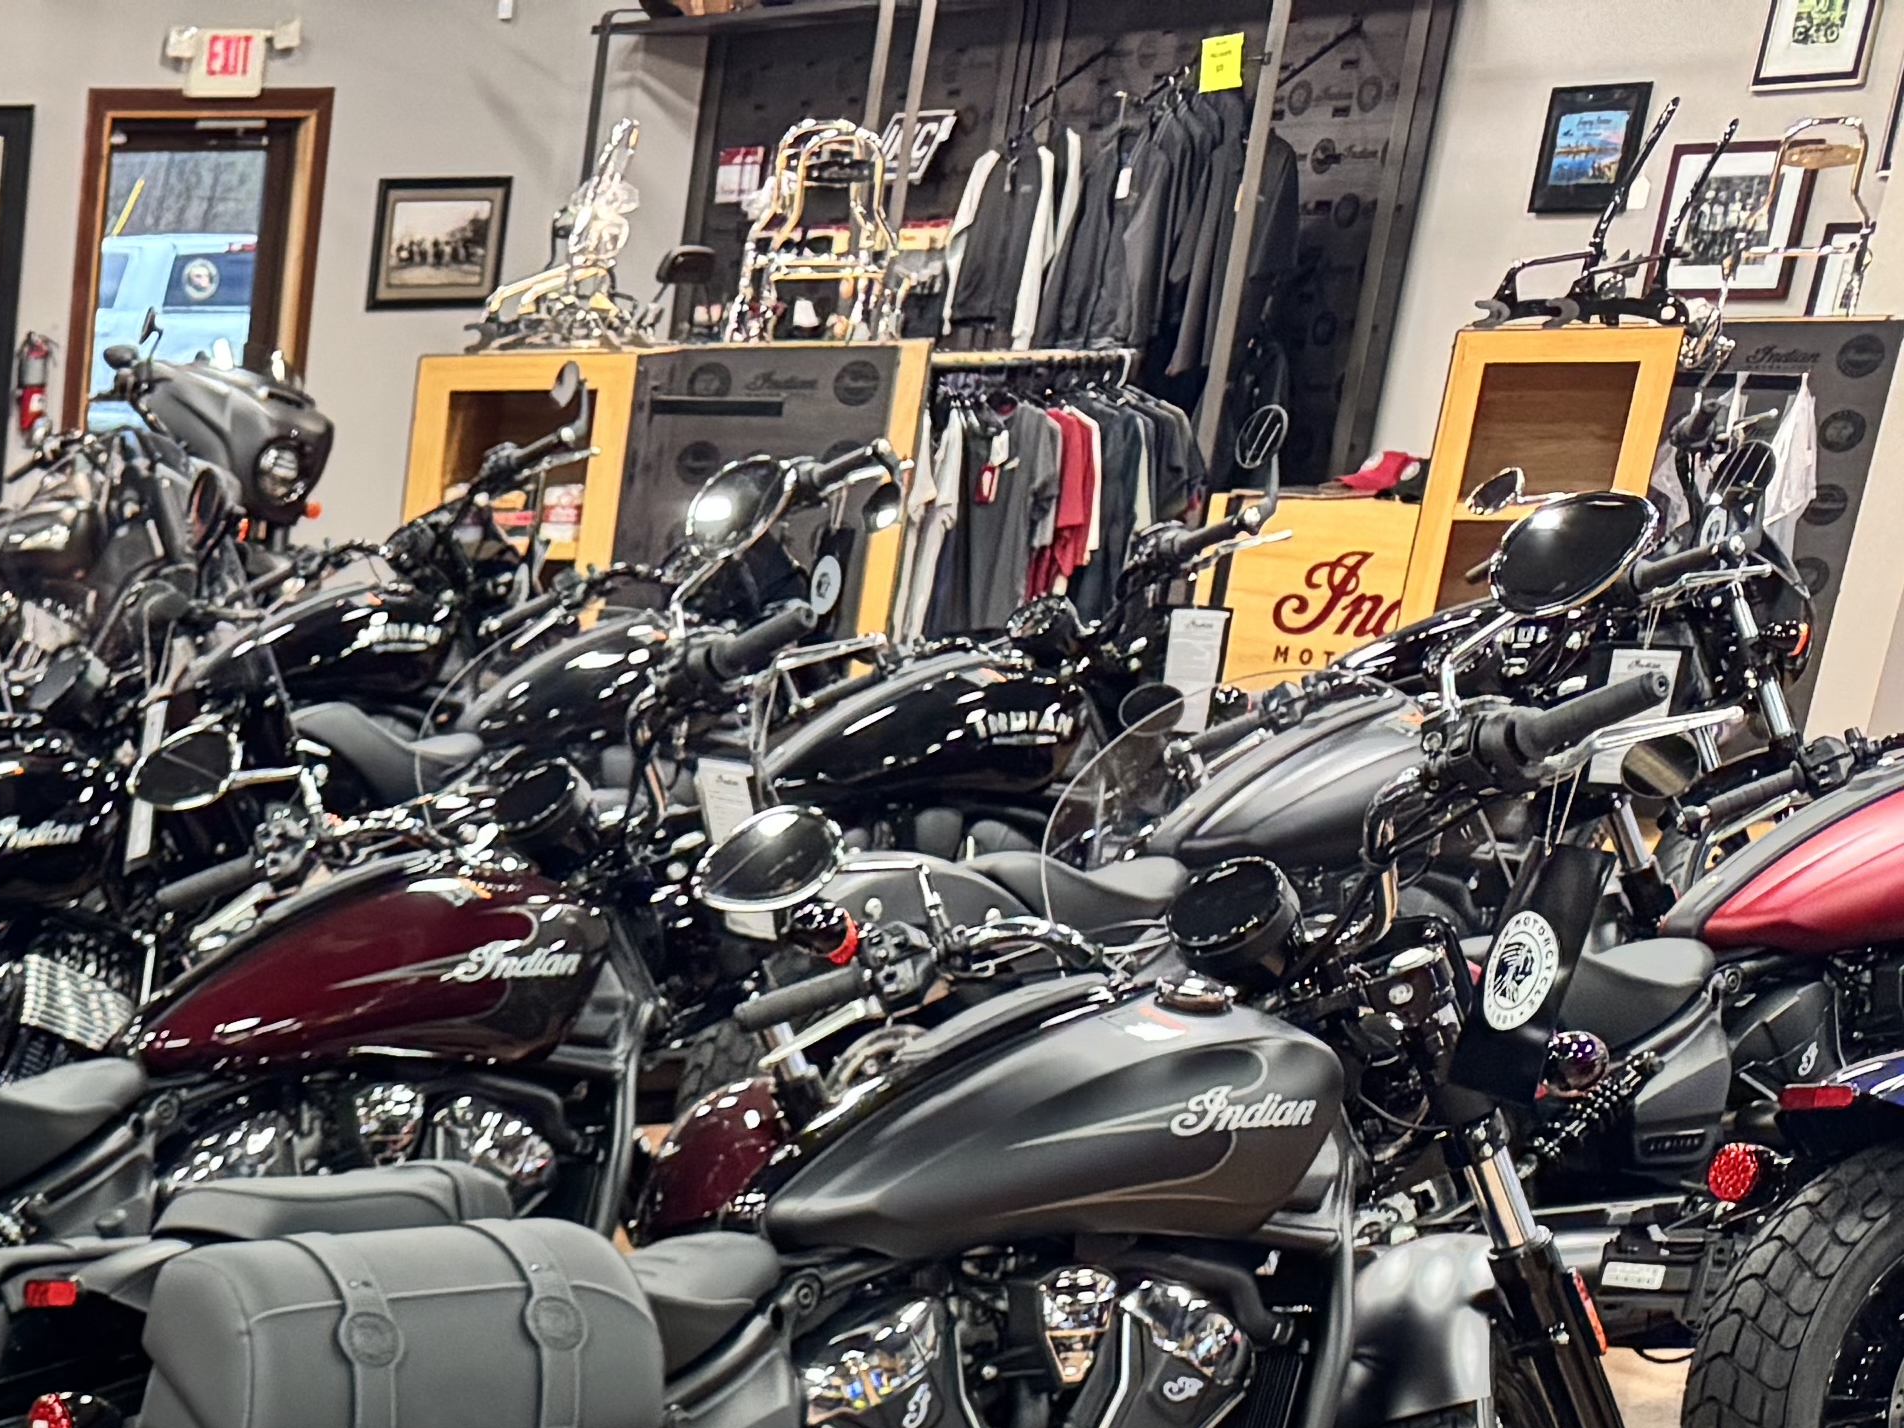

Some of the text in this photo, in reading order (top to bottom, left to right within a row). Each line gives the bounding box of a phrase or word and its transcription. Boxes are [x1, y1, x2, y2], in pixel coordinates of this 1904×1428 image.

[207, 35, 254, 76] EXIT
[450, 939, 583, 983] Indian
[1170, 1084, 1317, 1137] Indian
